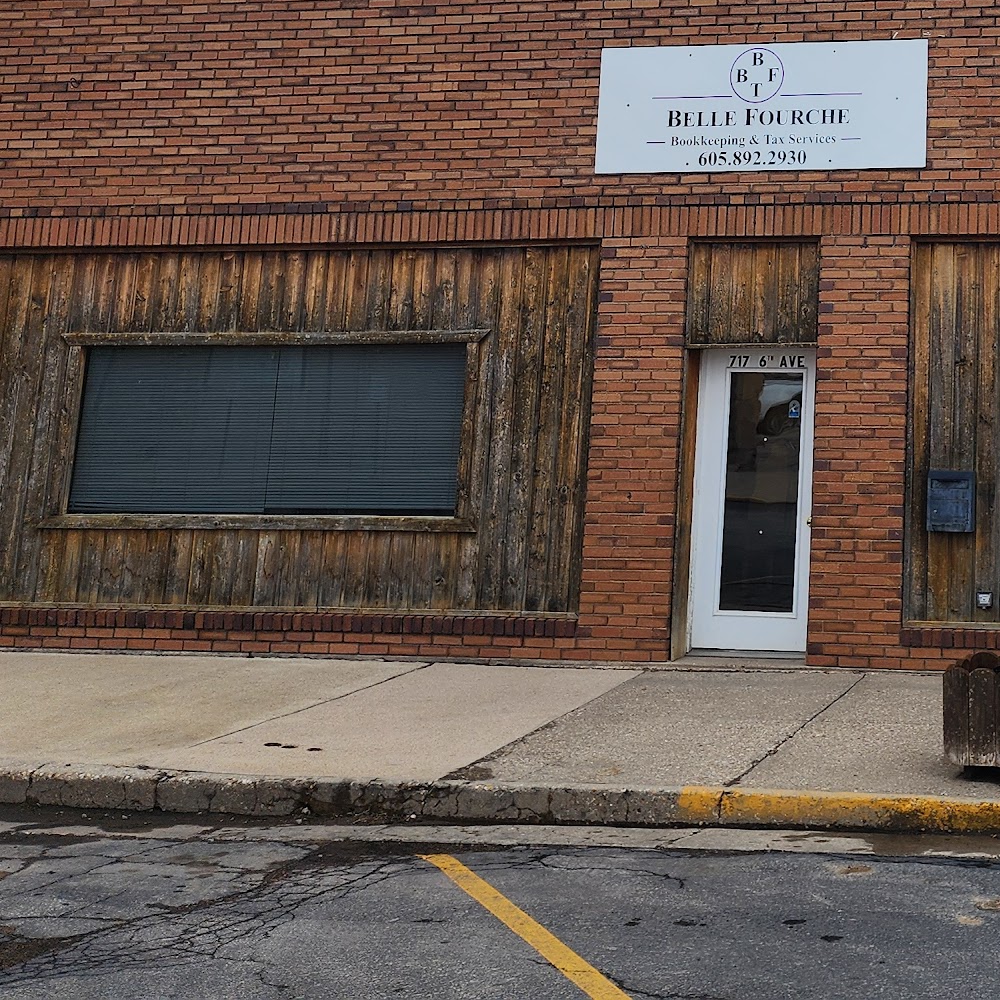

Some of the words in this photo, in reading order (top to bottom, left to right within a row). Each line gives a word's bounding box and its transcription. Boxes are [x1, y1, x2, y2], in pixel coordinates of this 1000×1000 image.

[752, 52, 764, 66] B
[736, 68, 748, 83] B
[767, 67, 779, 82] F
[750, 82, 763, 97] T
[667, 109, 737, 128] BELLE
[745, 108, 850, 126] FOURCHE
[671, 135, 746, 148] Bookkeeping
[749, 134, 759, 145] &
[764, 134, 784, 145] Tax
[788, 133, 837, 145] Services
[698, 149, 807, 167] 605.892.2930
[729, 355, 750, 367] 717
[780, 355, 805, 367] AVE
